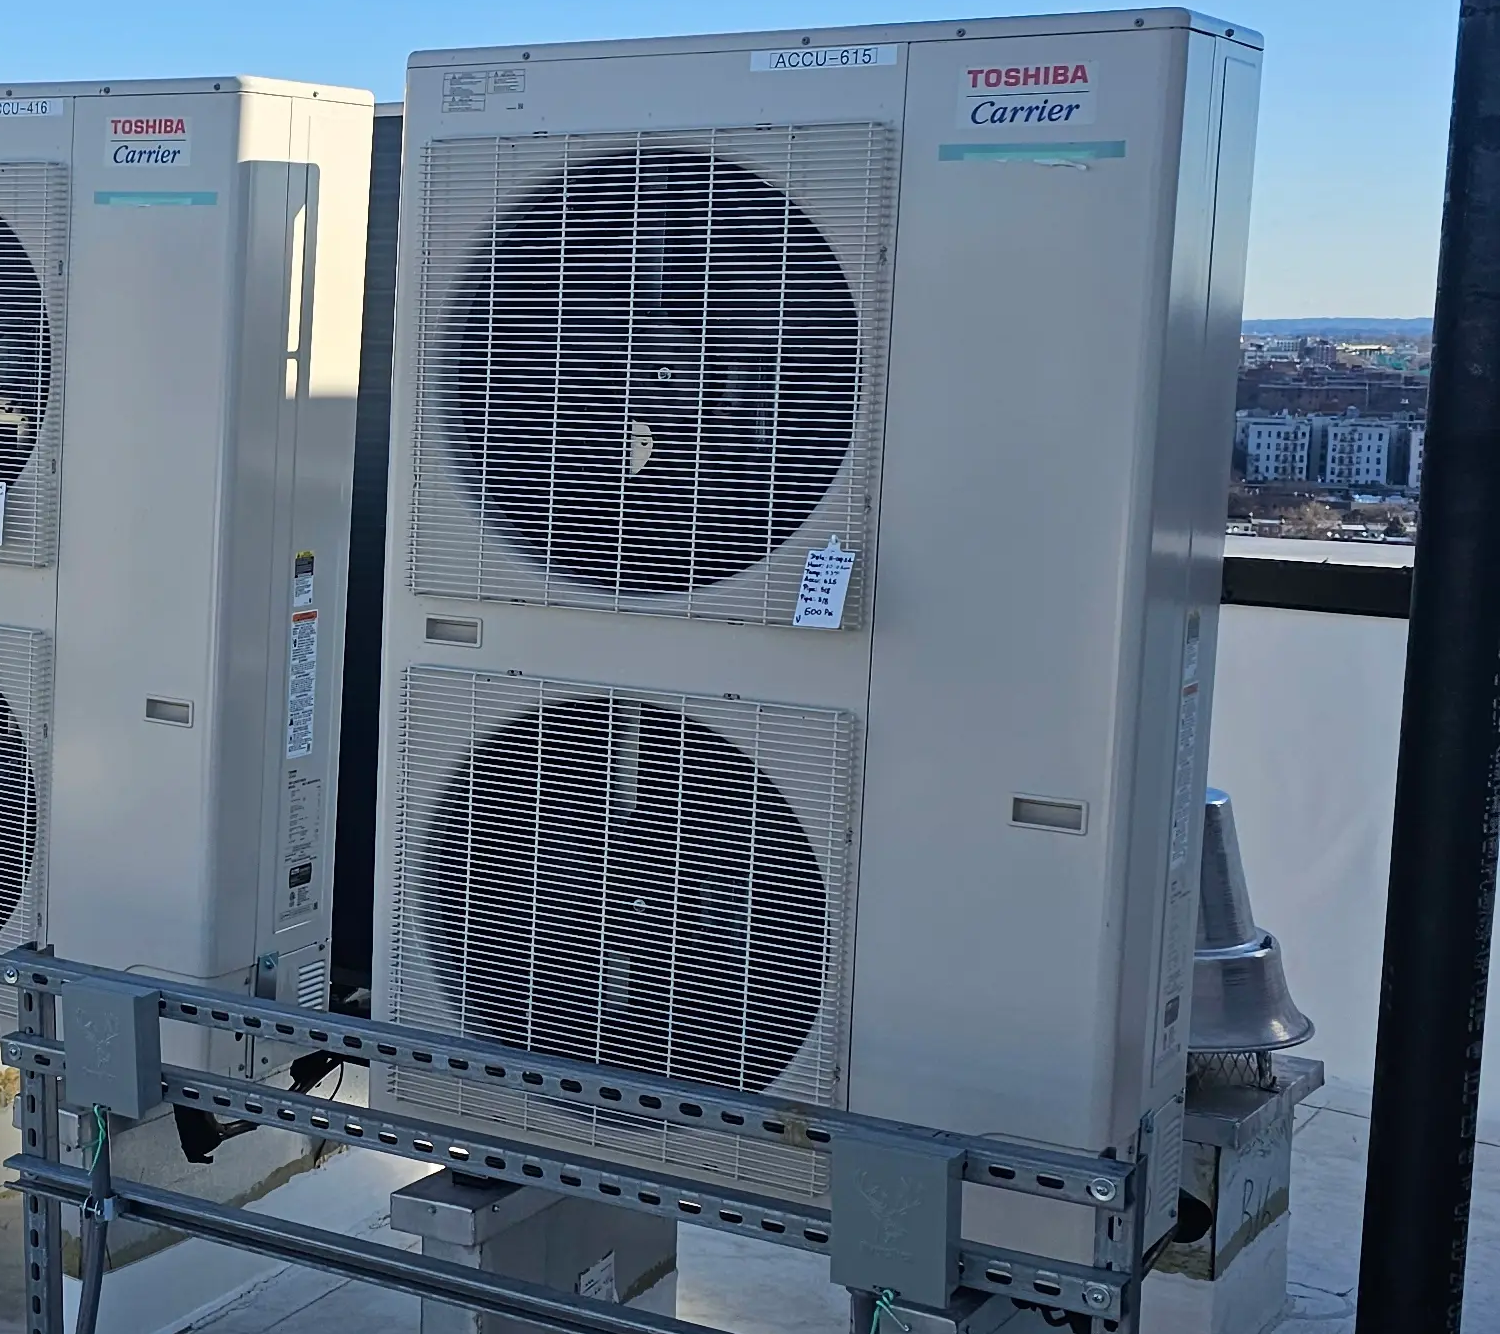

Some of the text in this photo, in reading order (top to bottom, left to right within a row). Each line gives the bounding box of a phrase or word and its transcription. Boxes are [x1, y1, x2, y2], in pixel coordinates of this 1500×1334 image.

[774, 47, 872, 69] ACCU-615
[967, 64, 1089, 88] TOSHIBA
[970, 98, 1081, 125] Carrier
[110, 118, 186, 135] TOSHIBA
[112, 144, 181, 164] Carrier
[804, 607, 822, 616] 600
